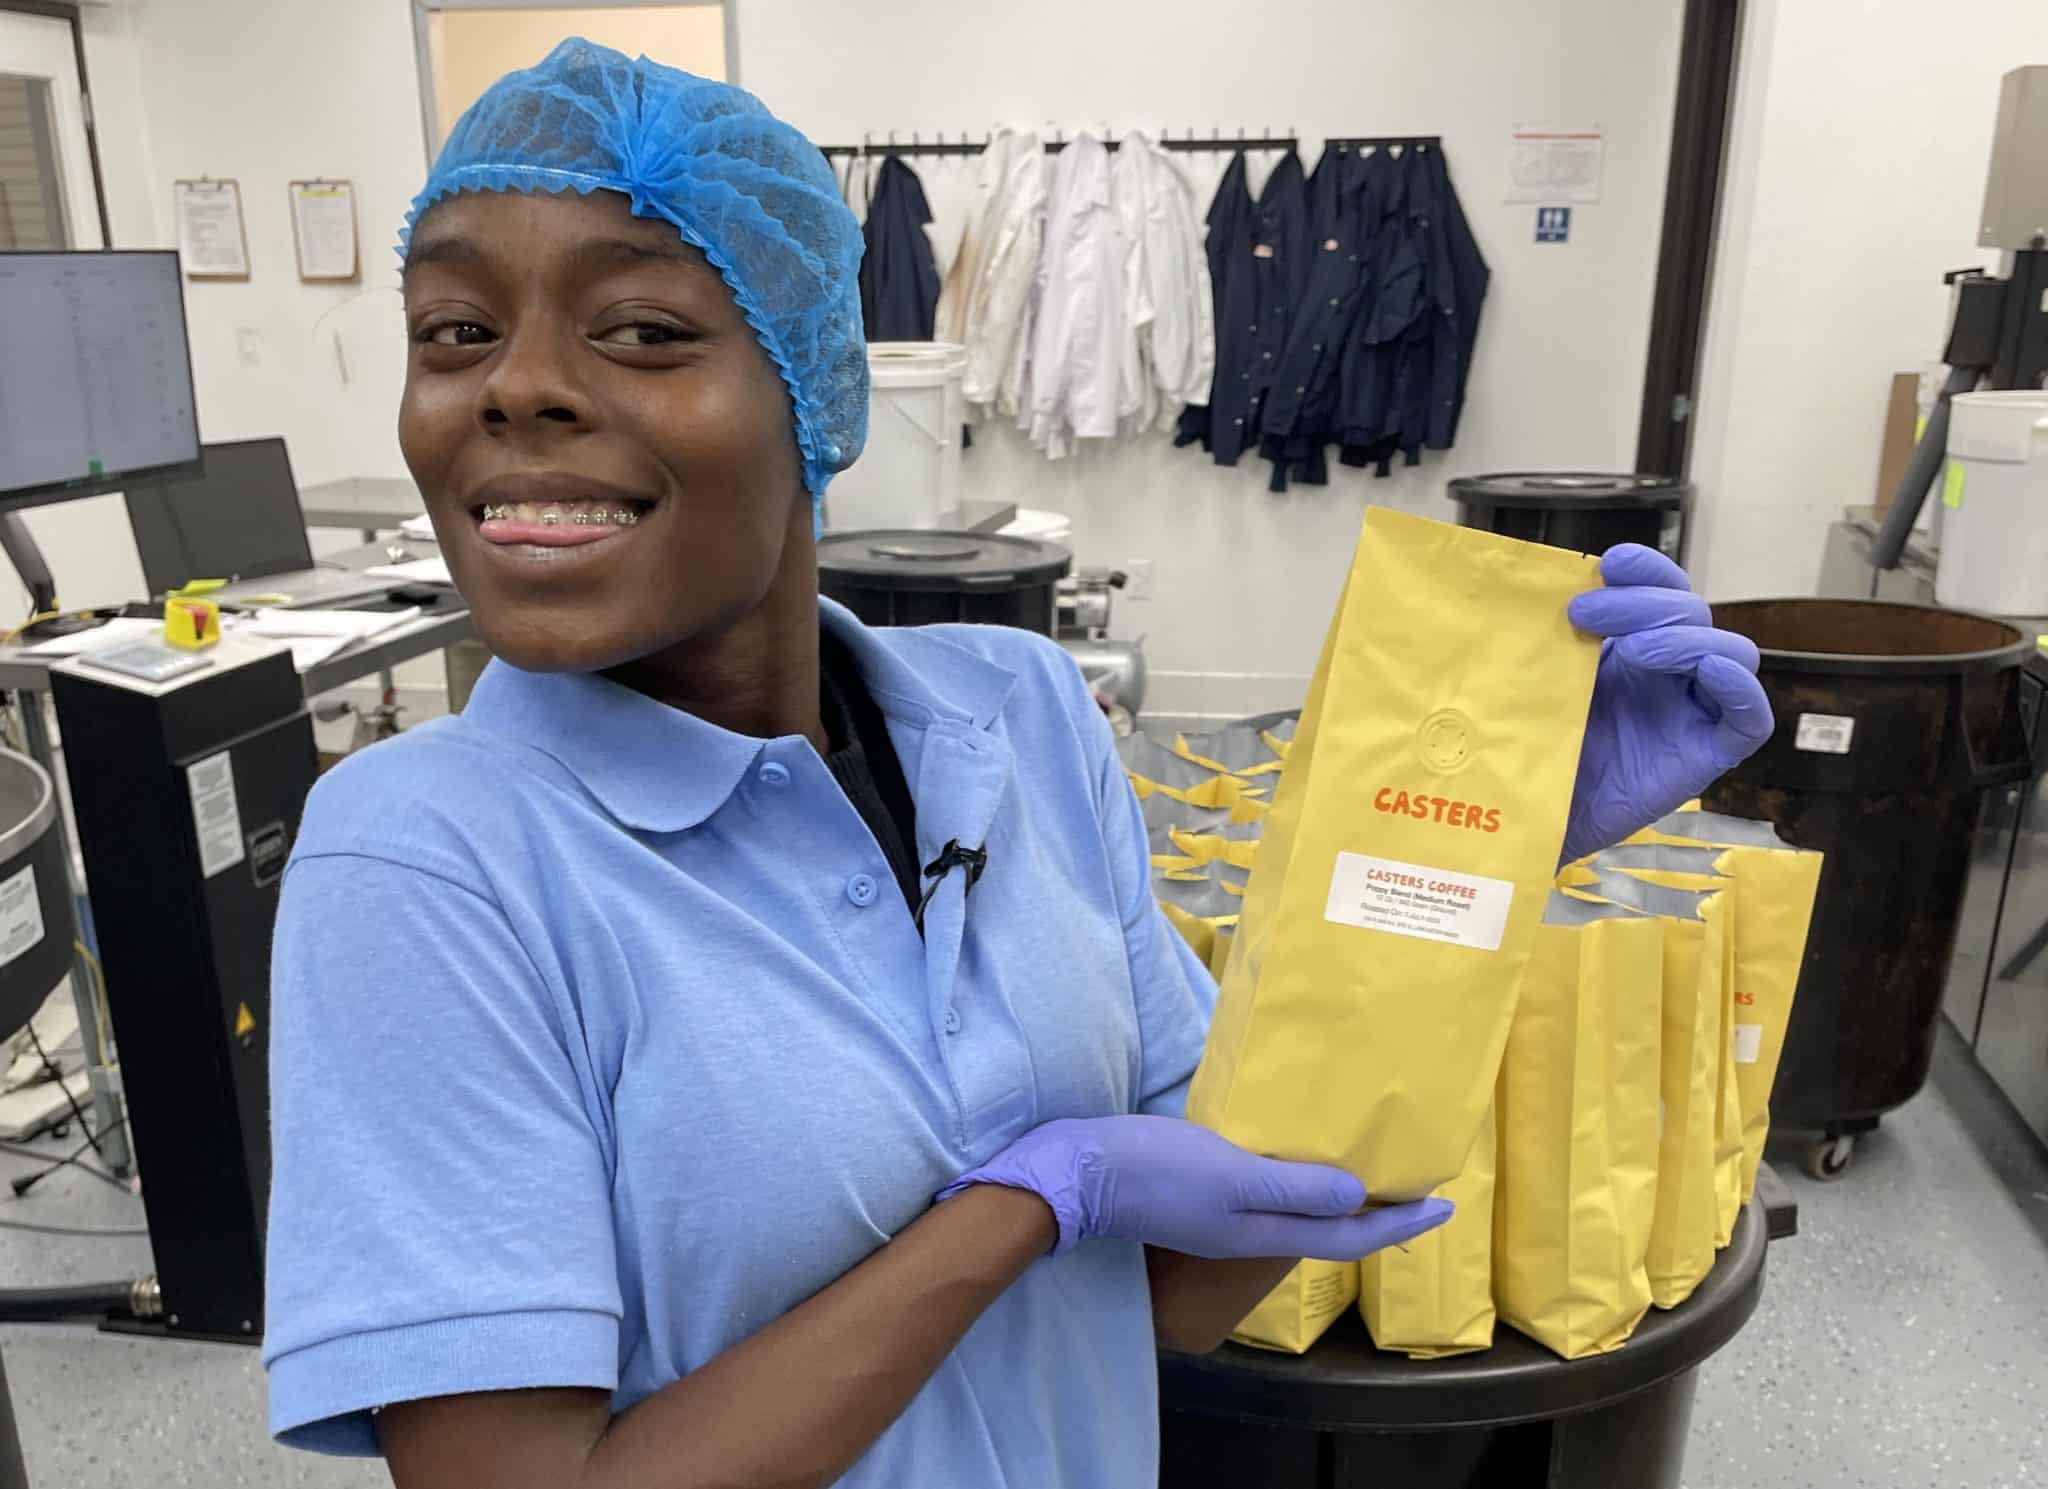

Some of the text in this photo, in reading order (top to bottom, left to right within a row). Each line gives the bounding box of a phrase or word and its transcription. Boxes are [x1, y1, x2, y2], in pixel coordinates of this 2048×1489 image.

[1374, 786, 1501, 833] CASTERS
[1367, 869, 1477, 900] CASTERS COFFEE
